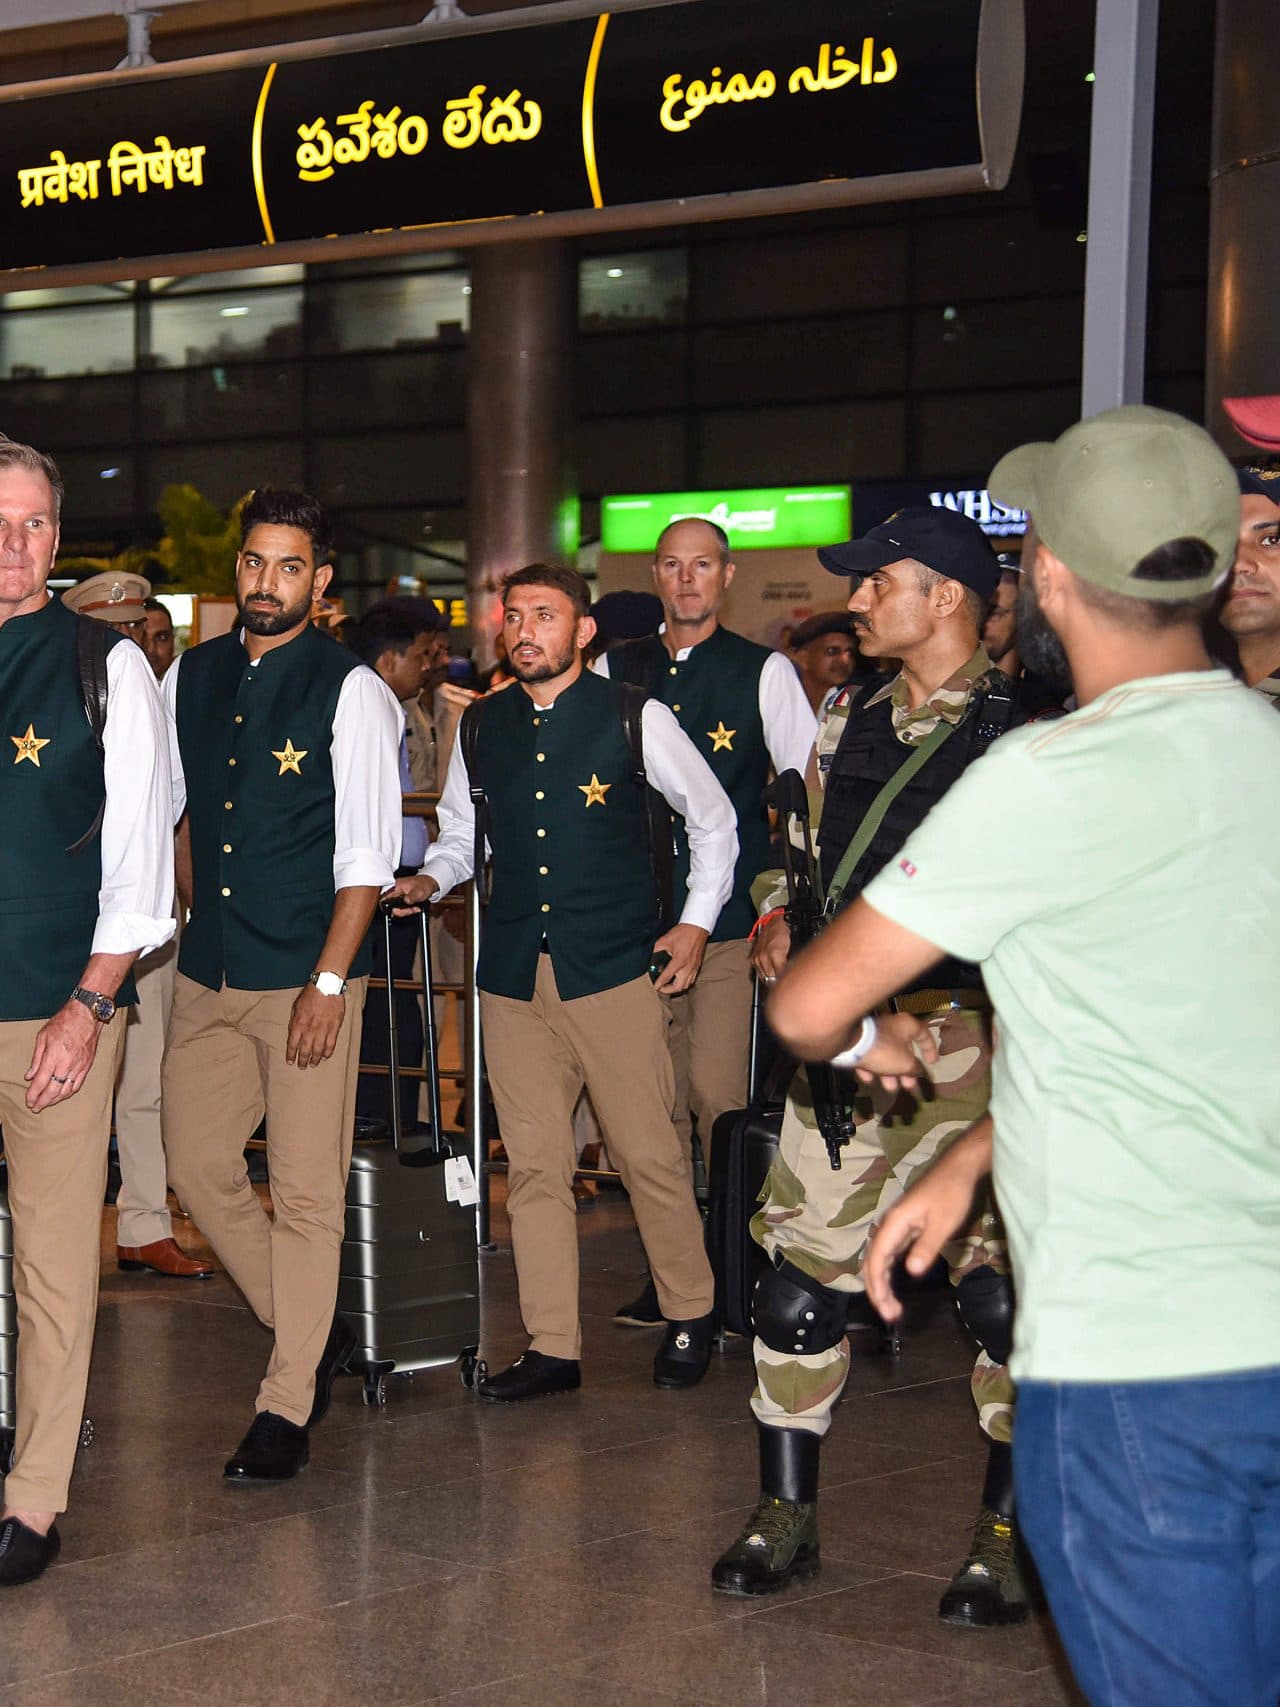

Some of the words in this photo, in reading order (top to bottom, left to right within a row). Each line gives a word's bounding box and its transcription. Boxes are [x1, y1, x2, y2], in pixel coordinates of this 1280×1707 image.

[296, 101, 428, 181] ప్రవేశం
[443, 85, 541, 148] లేదు
[660, 67, 776, 132] ممنوع
[18, 151, 101, 208] प्रवेश
[107, 136, 205, 196] निषेध
